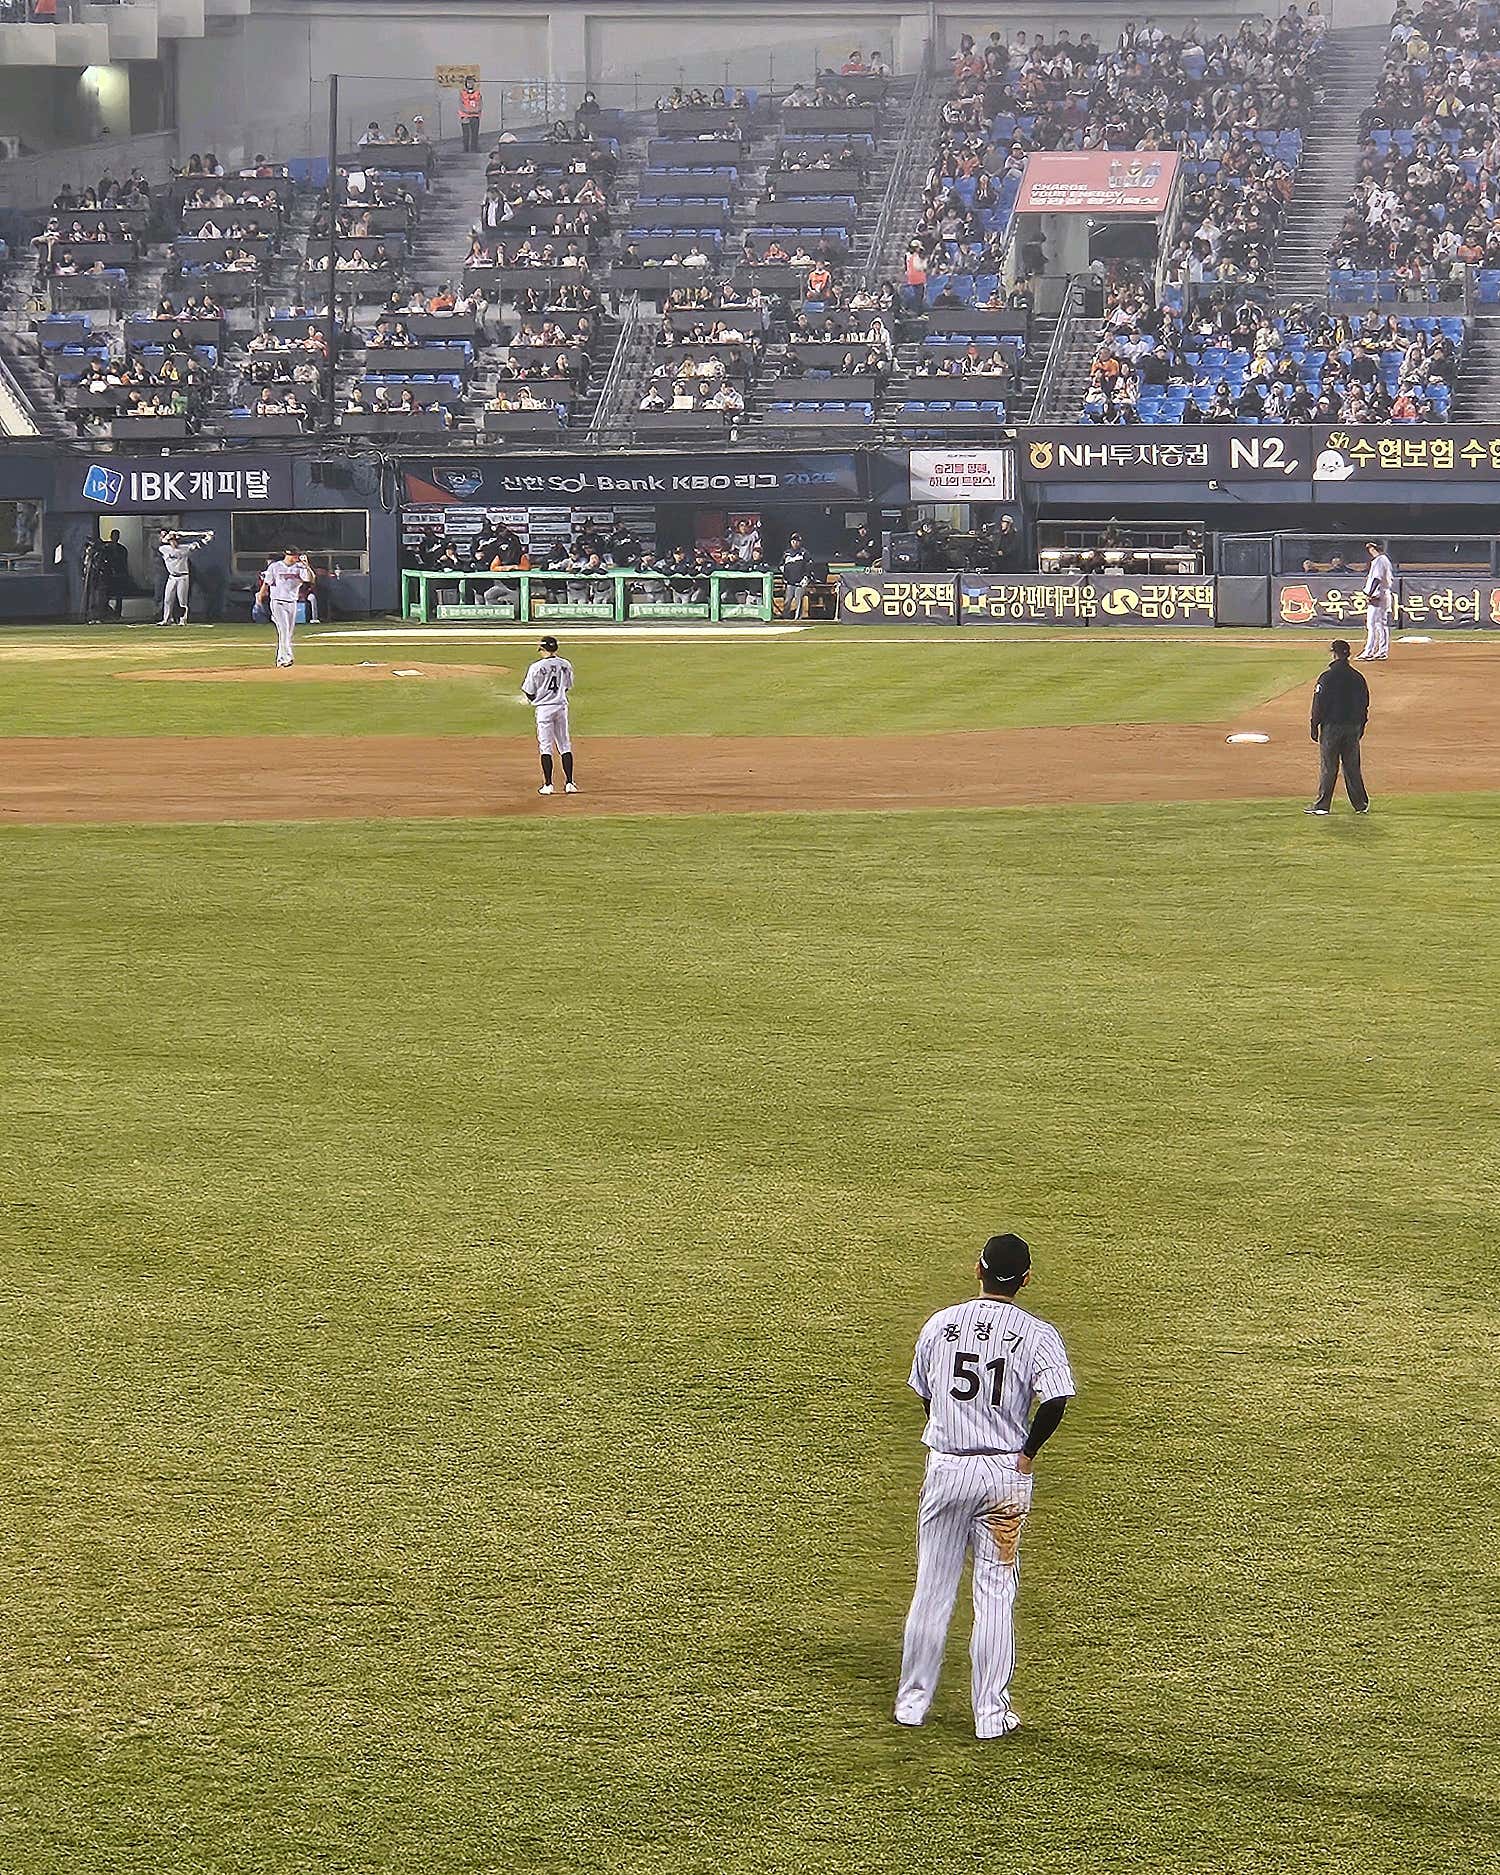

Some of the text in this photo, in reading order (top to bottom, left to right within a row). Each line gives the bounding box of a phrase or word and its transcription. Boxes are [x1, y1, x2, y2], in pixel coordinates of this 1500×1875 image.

[1058, 443, 1208, 468] NH투자증권
[1326, 431, 1350, 450] Sh
[1350, 438, 1454, 469] 수협보험
[130, 470, 271, 501] IBK캐피탈
[598, 475, 665, 491] Bank
[672, 474, 730, 490] KBO
[734, 474, 779, 489] 리그
[882, 583, 956, 617] 금강주택
[989, 584, 1098, 618] 금강펜테리움
[1141, 585, 1214, 619] 금강주택
[548, 676, 559, 693] 4
[949, 1351, 1006, 1407] 51
